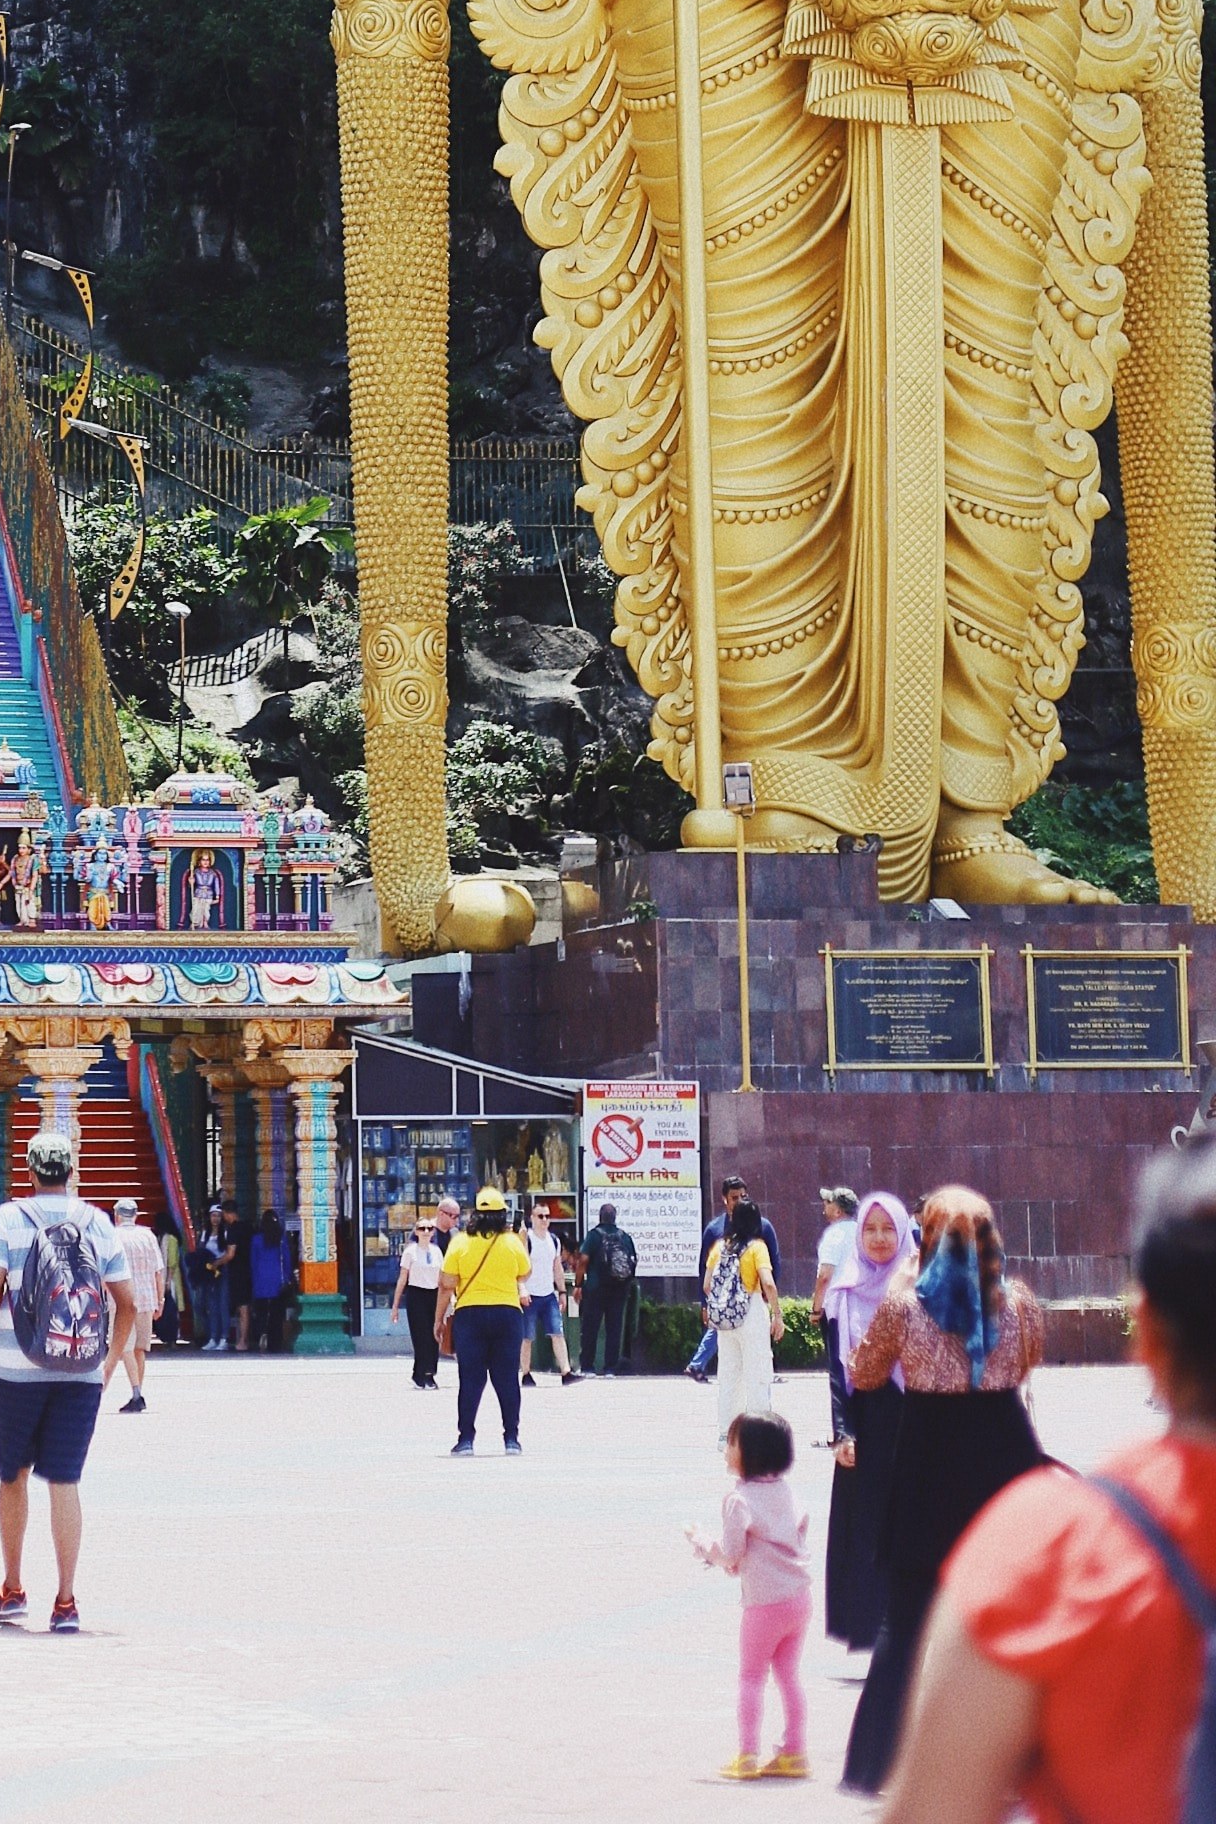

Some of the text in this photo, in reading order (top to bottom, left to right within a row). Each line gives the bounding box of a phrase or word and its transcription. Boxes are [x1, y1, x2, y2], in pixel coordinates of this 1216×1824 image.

[610, 1084, 648, 1092] MEMASUKI
[599, 1121, 638, 1160] NO SMOKING
[659, 1205, 679, 1217] 8.30
[657, 1231, 680, 1239] GATE
[637, 1243, 673, 1251] OPENING
[652, 1255, 661, 1263] TO
[662, 1253, 684, 1263] 8.30
[685, 1255, 697, 1263] PM
